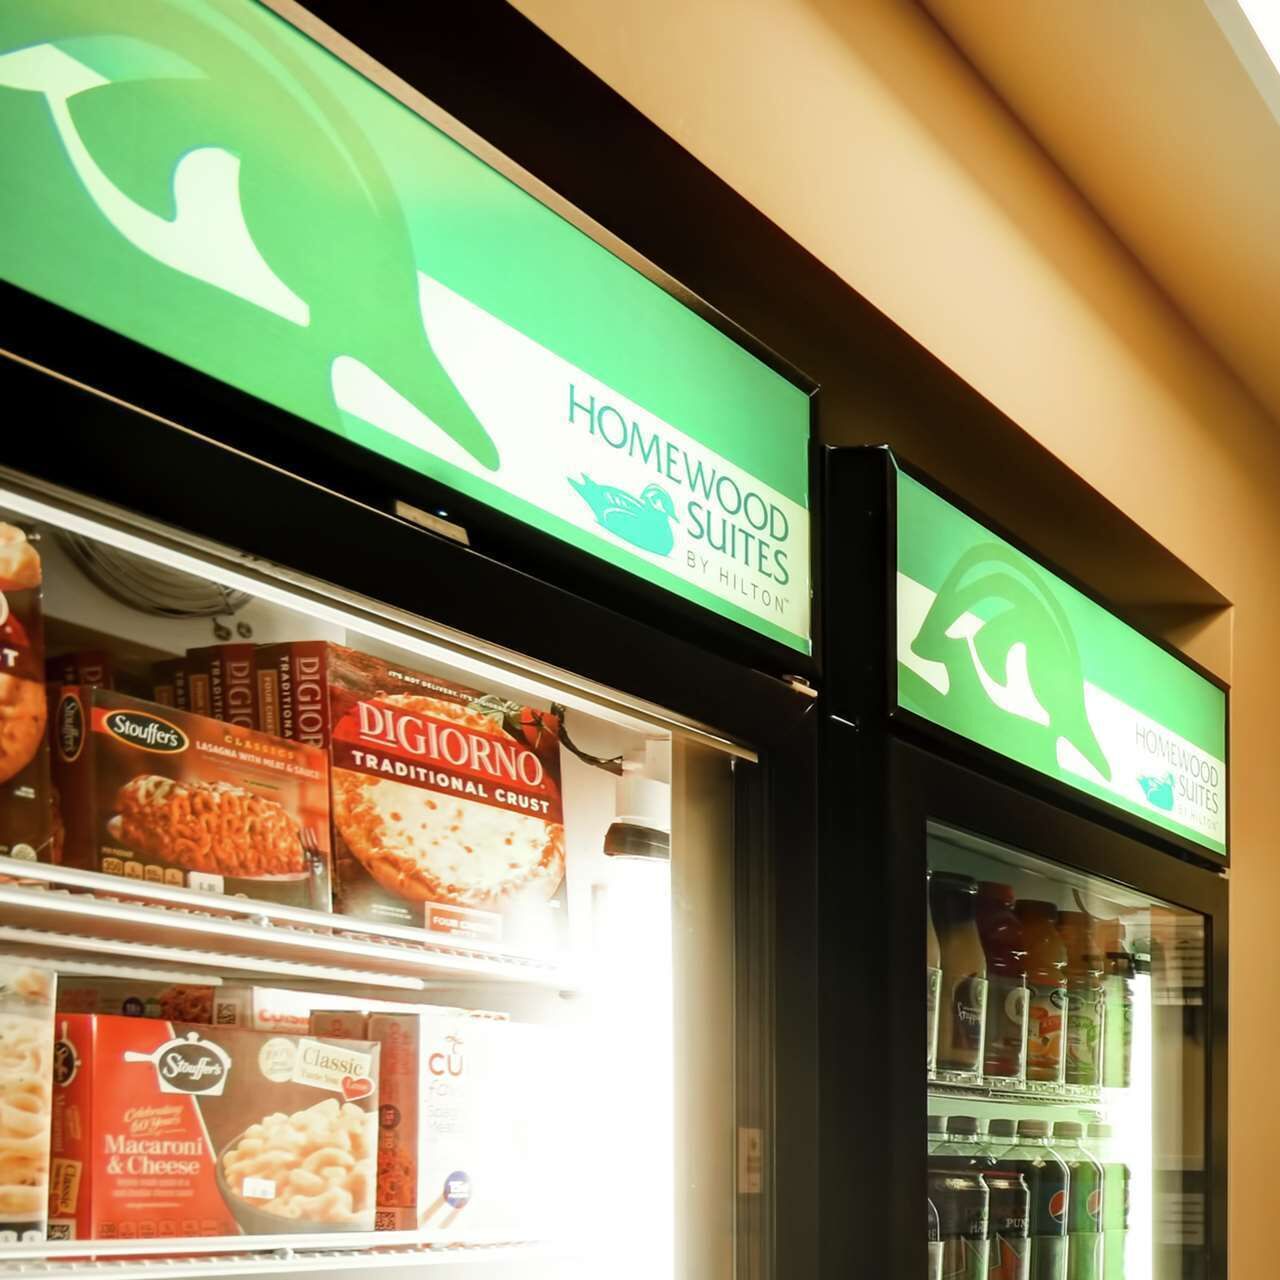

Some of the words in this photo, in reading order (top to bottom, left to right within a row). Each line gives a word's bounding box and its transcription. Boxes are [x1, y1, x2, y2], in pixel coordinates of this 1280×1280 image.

[568, 383, 789, 542] HOMEWOOD
[687, 501, 789, 585] SUITES
[686, 550, 708, 573] BY
[719, 568, 785, 613] HILTON
[113, 715, 180, 747] Stouffer's
[196, 740, 237, 759] LASAGNA
[357, 701, 544, 786] DIGIORNO
[1135, 721, 1218, 787] HOMEWOOD
[352, 751, 488, 797] TRADITIONAL
[495, 789, 549, 813] CRUST
[1179, 774, 1218, 814] SUITES
[163, 1052, 221, 1080] Stouffer's
[303, 1046, 364, 1077] Classic
[104, 1134, 203, 1156] Macaroni
[106, 1157, 125, 1174] &
[127, 1155, 200, 1175] Cheese
